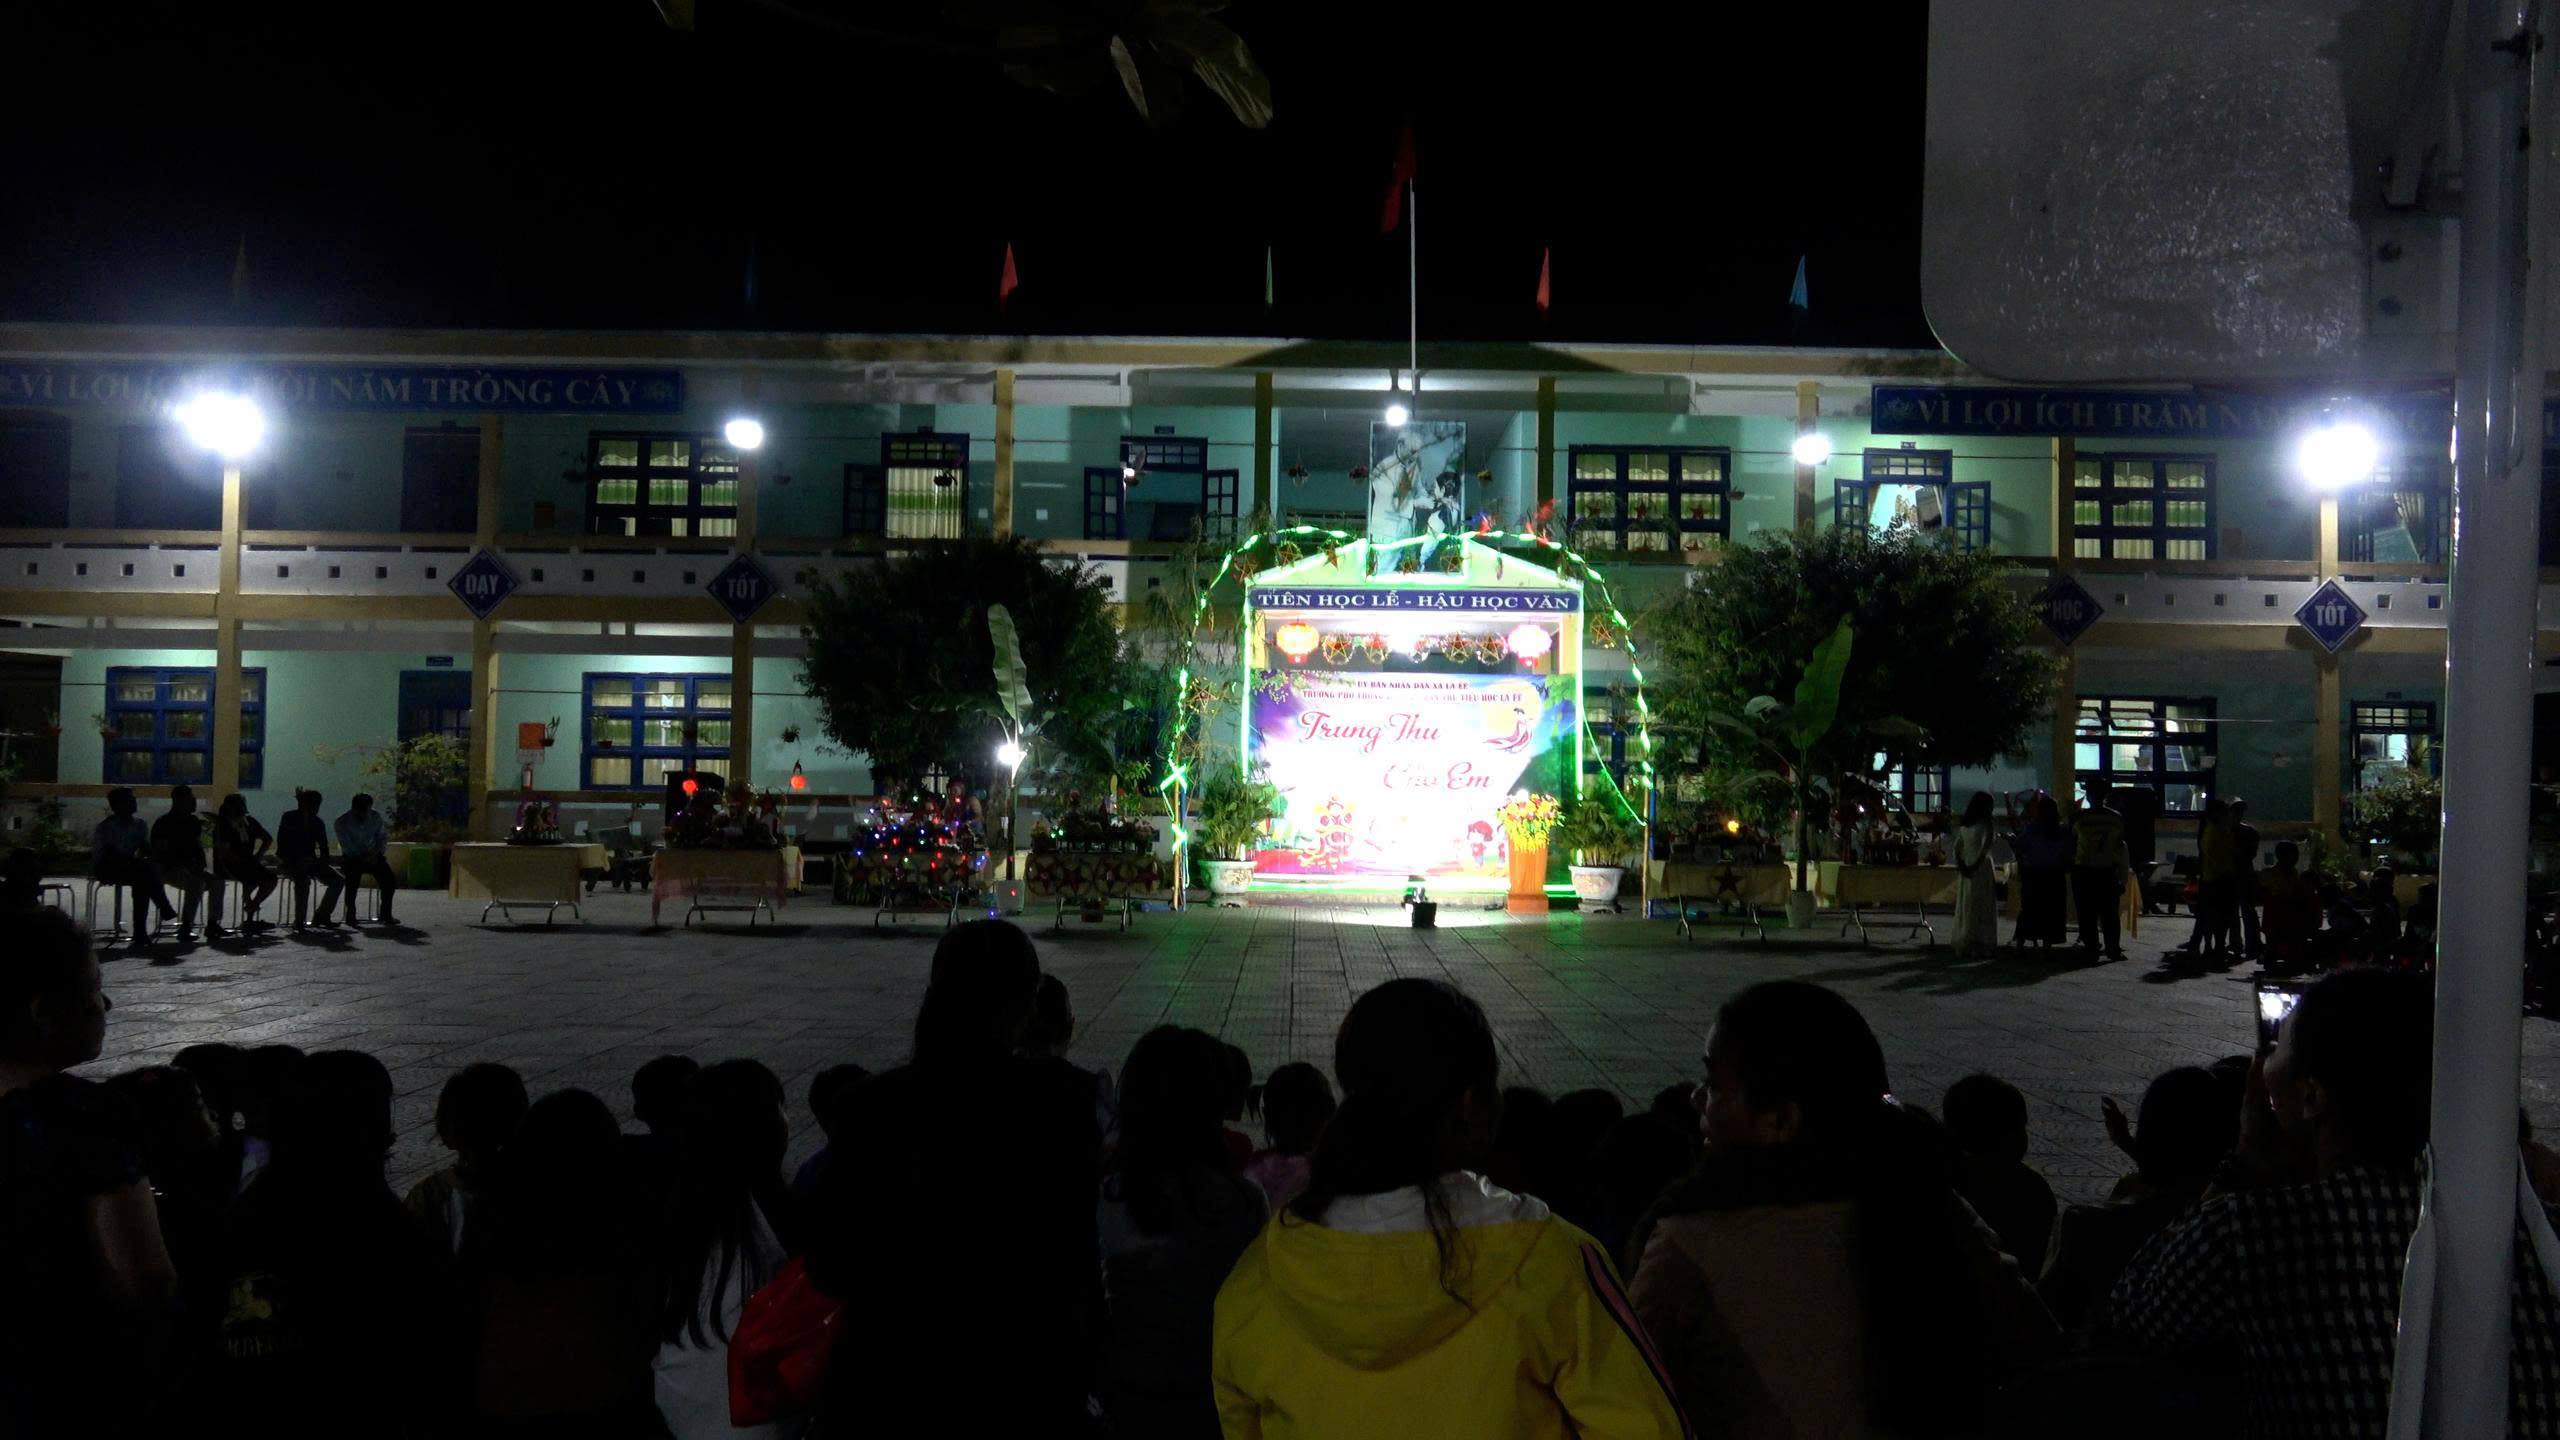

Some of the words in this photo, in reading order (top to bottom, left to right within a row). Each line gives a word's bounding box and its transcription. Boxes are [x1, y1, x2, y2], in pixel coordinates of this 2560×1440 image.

[333, 371, 410, 402] NĂM
[423, 369, 553, 404] TRỒNG
[566, 374, 637, 405] CÂY
[1917, 393, 1950, 424] VÌ
[1963, 397, 2022, 430] LỢI
[2035, 394, 2096, 427] ÍCH
[2109, 397, 2208, 429] TRĂM
[465, 574, 499, 599] DẠY
[727, 571, 759, 600] TỐT
[1258, 591, 1312, 606] TIÊN
[1318, 594, 1365, 609] HỌC
[1371, 589, 1400, 606] LỄ
[1418, 592, 1464, 609] HẬU
[1471, 596, 1518, 610] HỌC
[1523, 594, 1570, 609] VĂN
[2052, 599, 2083, 624] HỌC
[2315, 598, 2347, 626] TỐT
[1300, 711, 1383, 753] Trung
[1389, 713, 1440, 741] Thu
[1447, 761, 1490, 790] Em
